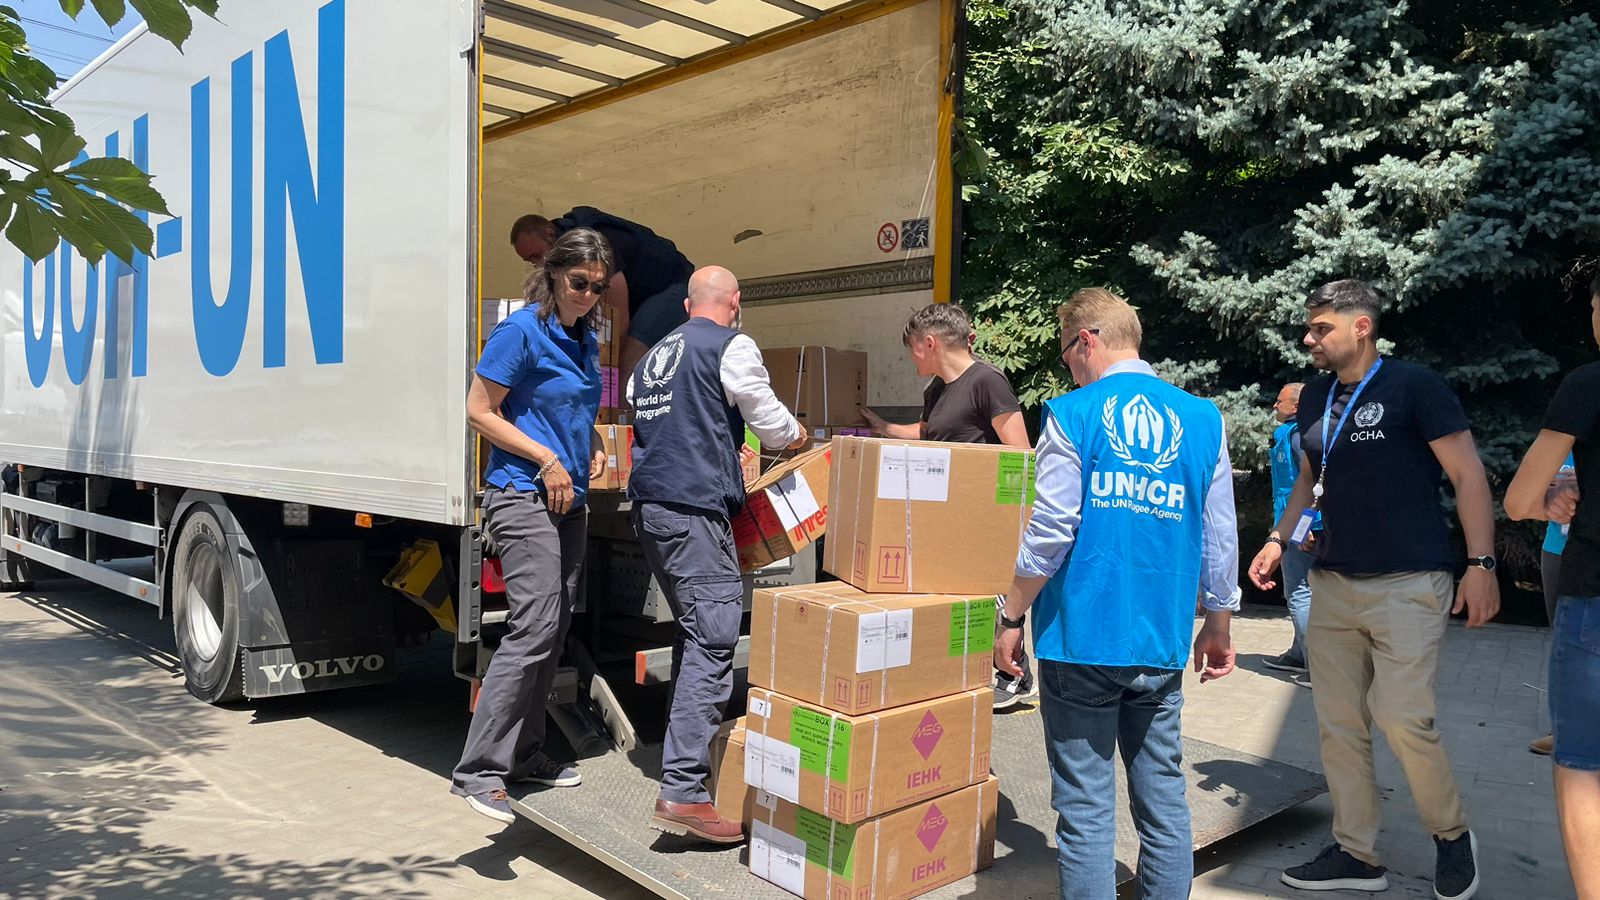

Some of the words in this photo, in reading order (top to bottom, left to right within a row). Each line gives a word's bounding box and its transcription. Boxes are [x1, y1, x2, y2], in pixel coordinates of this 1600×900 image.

[636, 393, 658, 407] World
[1350, 429, 1386, 443] OCHA
[1091, 471, 1185, 509] UNHCR
[1090, 498, 1110, 508] The
[1111, 498, 1127, 508] UN
[1150, 506, 1184, 522] Agency
[259, 654, 385, 683] VOLVO
[759, 702, 763, 711] 7
[815, 715, 830, 727] BOX
[912, 722, 941, 738] MEG
[907, 765, 942, 789] IEHK
[765, 794, 769, 803] 7
[916, 814, 945, 833] MEG
[912, 857, 946, 882] IEHK
